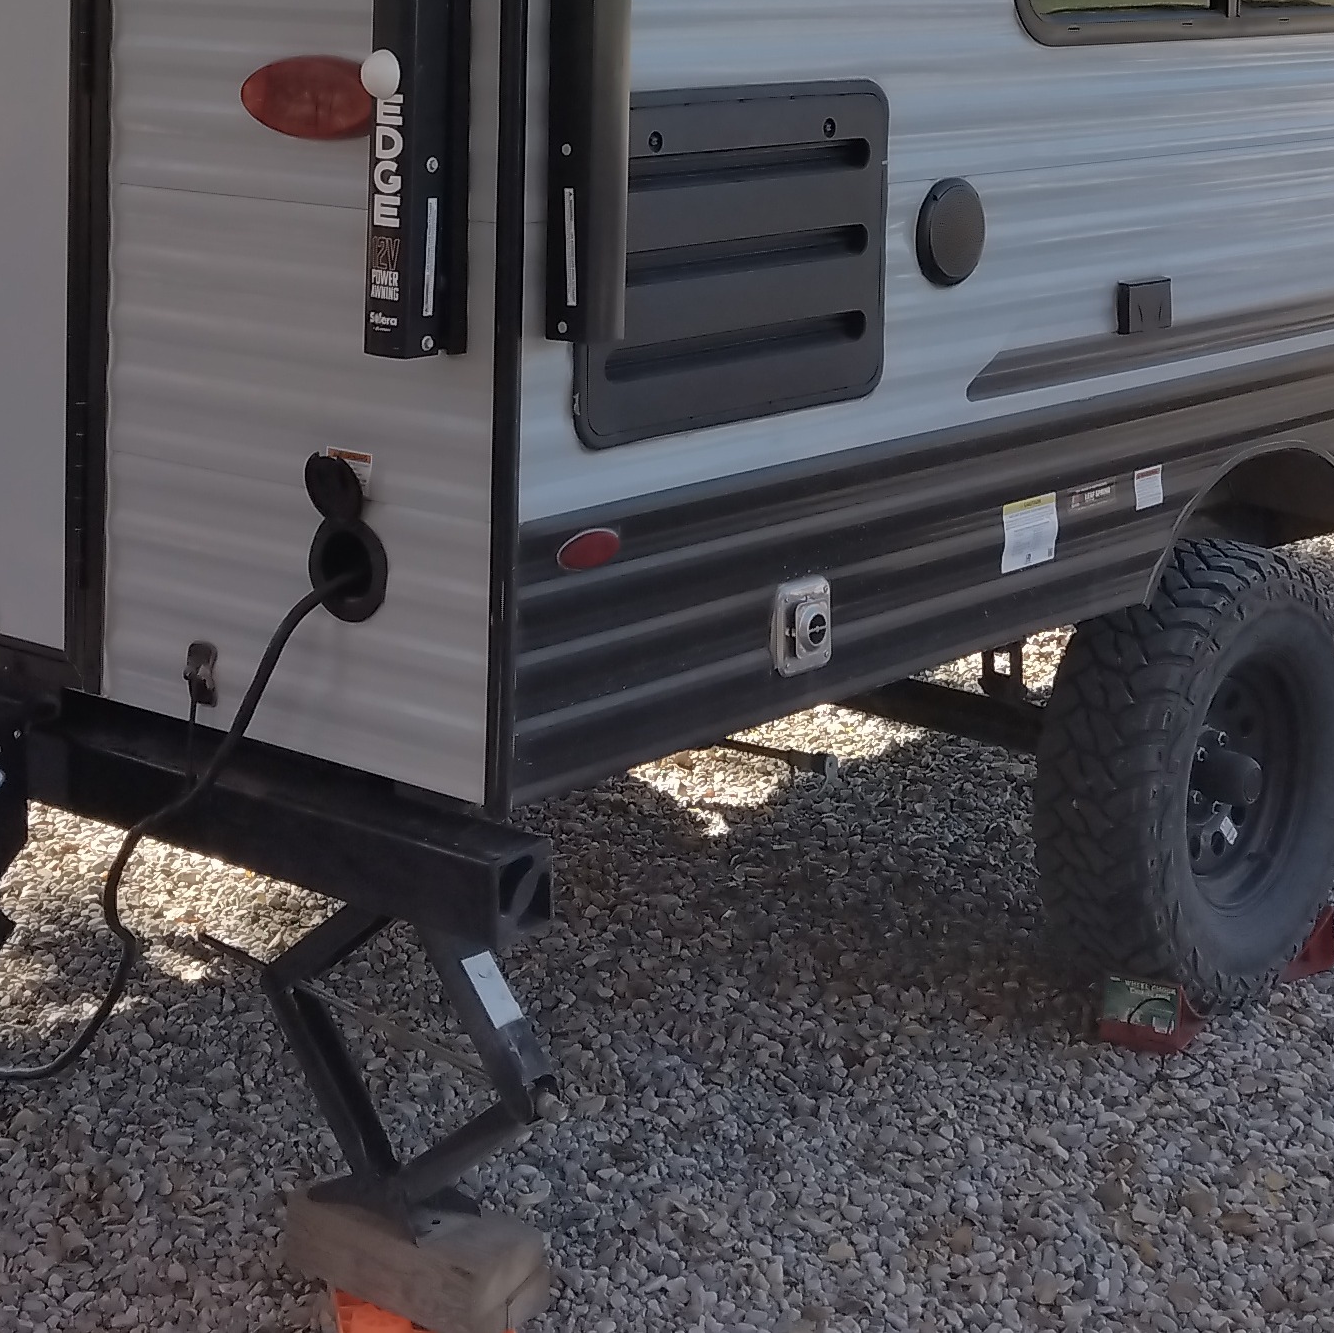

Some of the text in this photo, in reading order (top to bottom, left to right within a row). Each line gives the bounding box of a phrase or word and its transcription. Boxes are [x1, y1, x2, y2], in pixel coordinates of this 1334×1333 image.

[373, 93, 404, 228] EDGE
[372, 235, 400, 270] 12V
[371, 269, 399, 287] POWER
[370, 285, 399, 302] AWNING
